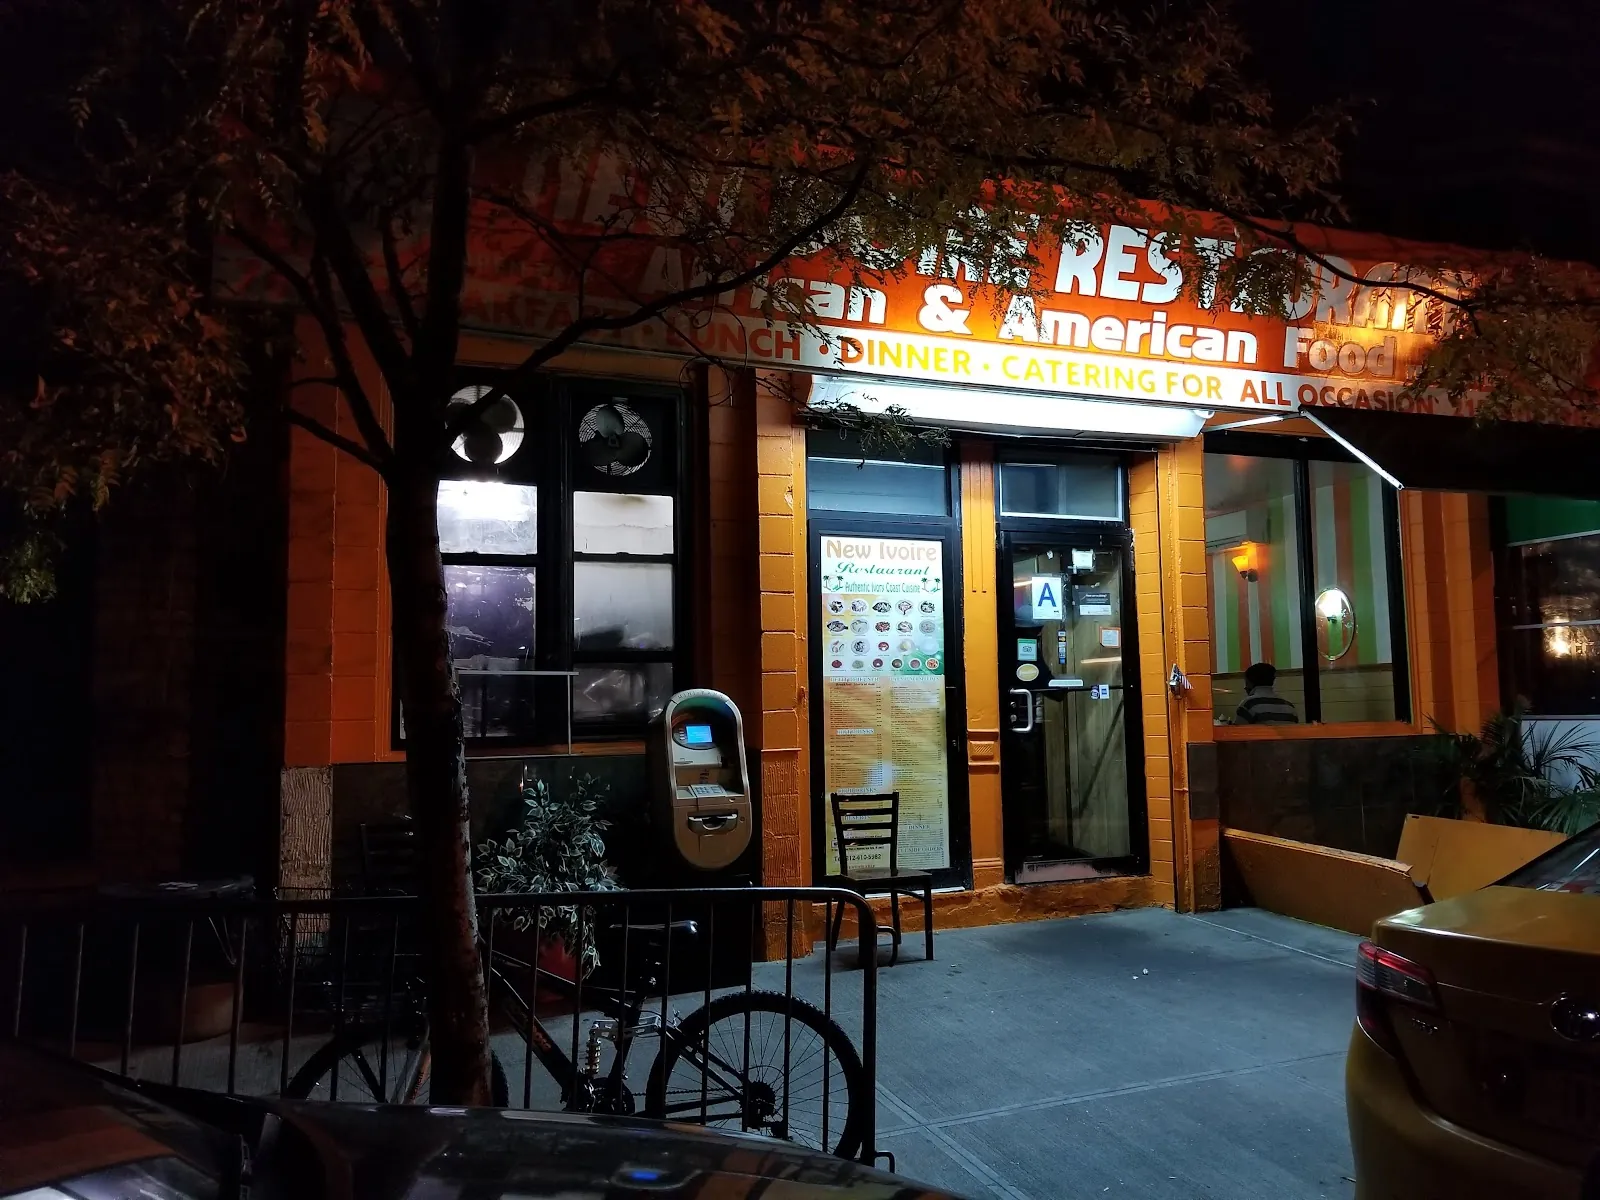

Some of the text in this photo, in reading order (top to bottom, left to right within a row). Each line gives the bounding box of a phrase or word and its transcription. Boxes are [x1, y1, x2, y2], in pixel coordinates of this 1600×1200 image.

[917, 284, 973, 336] &
[998, 294, 1259, 366] American
[1283, 326, 1398, 379] Food
[664, 319, 801, 361] LUNCH
[840, 337, 971, 376] DINNER
[1001, 355, 1157, 396] CATERING
[1165, 372, 1223, 403] FOR
[1240, 378, 1292, 407] ALL
[826, 540, 938, 562] New Ivoire
[835, 562, 930, 576] Restaurant
[845, 582, 870, 593] Authentic
[886, 583, 901, 593] Coast
[901, 583, 920, 594] Cuisine
[1037, 582, 1057, 607] A
